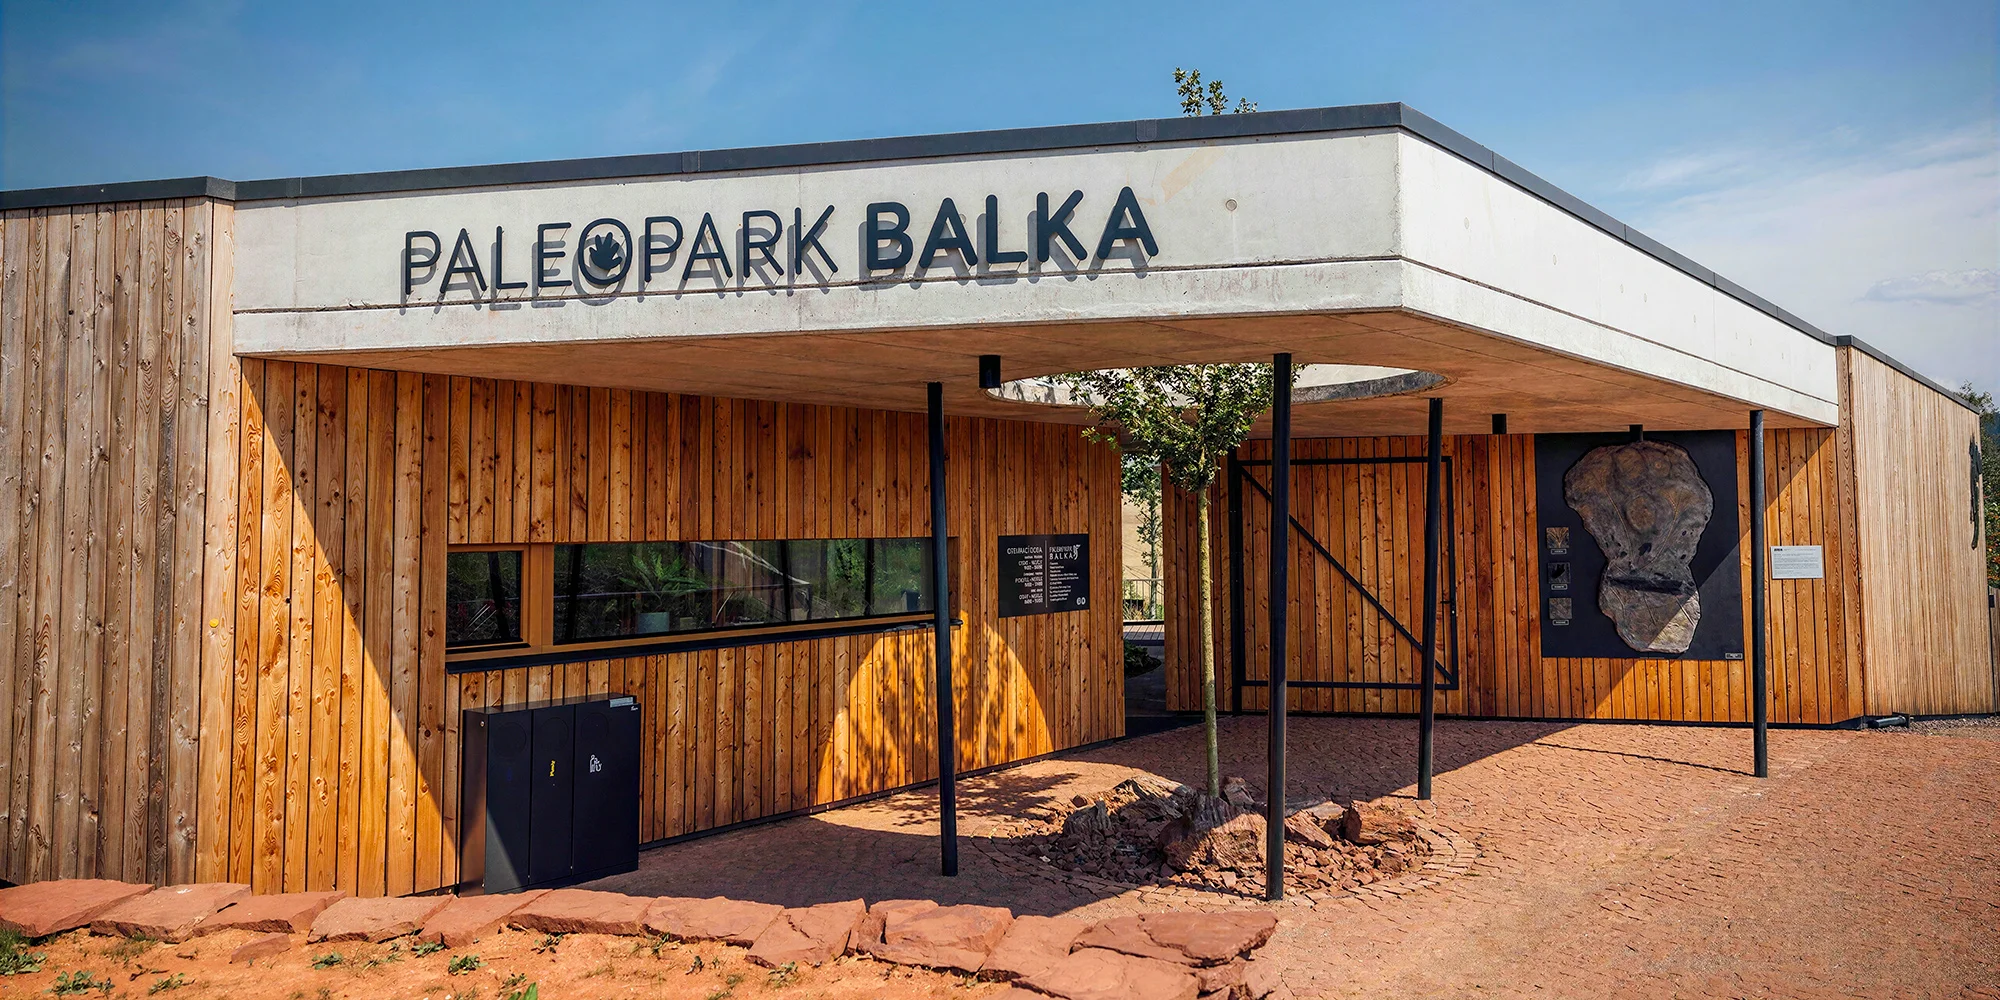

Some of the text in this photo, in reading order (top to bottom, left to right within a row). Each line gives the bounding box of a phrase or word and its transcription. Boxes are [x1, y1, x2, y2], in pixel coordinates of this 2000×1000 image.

[404, 186, 1160, 296] PALEOPARK BALKA
[1049, 552, 1074, 560] BALKA
